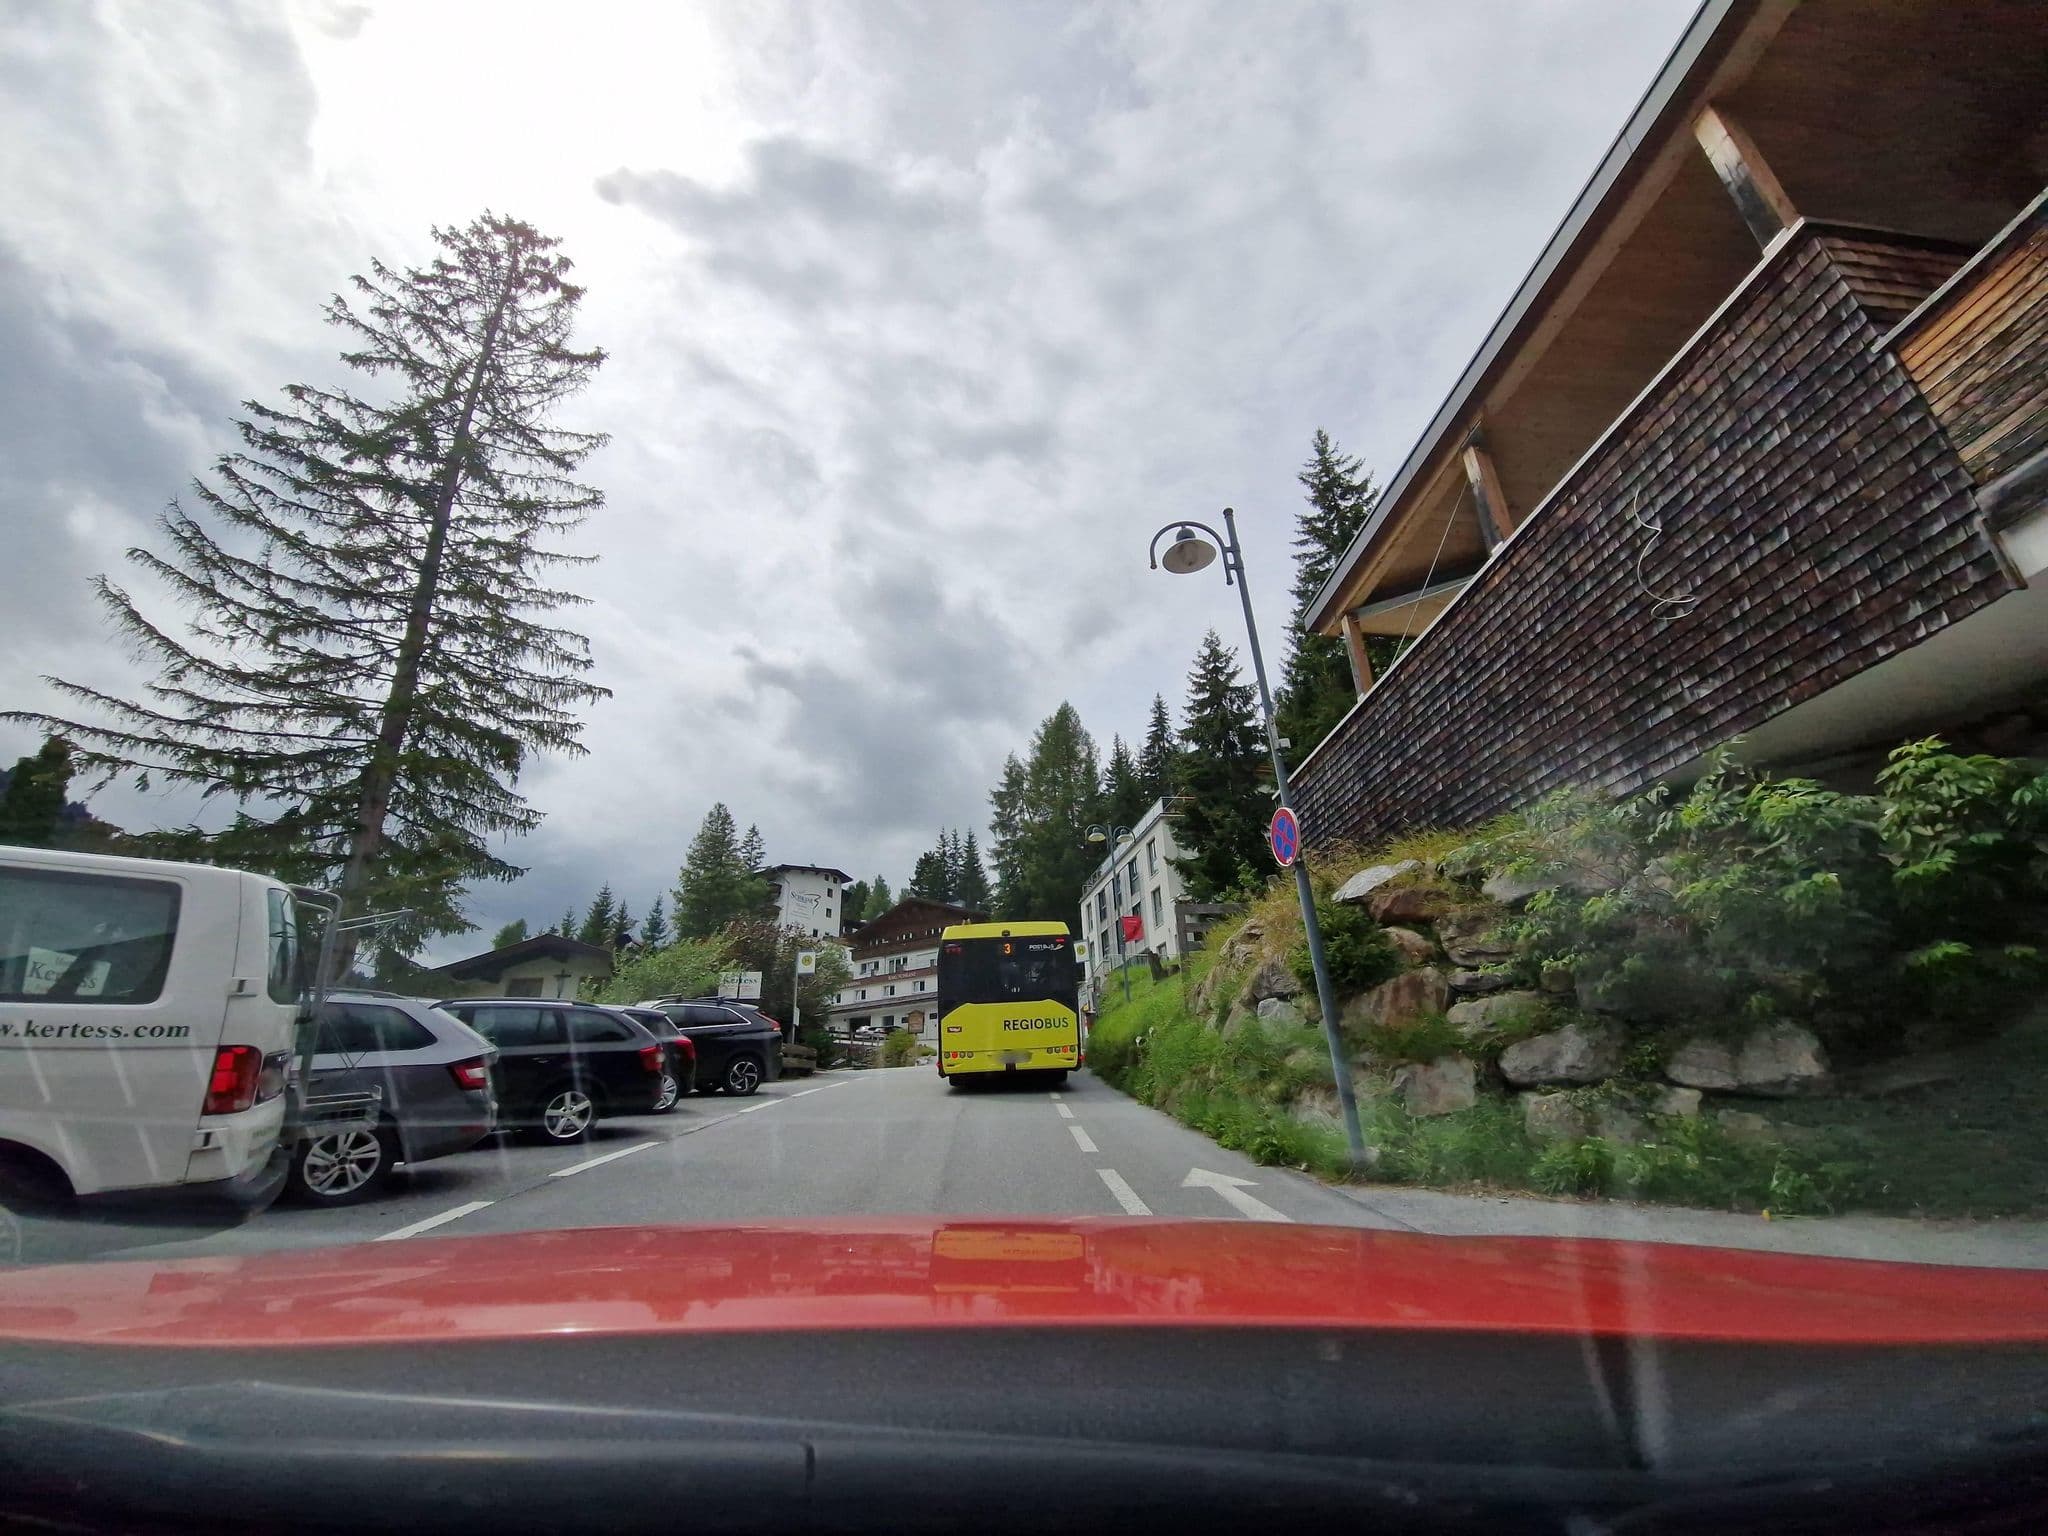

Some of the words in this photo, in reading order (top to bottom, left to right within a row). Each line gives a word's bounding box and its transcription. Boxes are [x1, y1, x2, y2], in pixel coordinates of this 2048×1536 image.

[1004, 943, 1010, 954] 3
[27, 960, 97, 989] Kess
[1003, 1017, 1069, 1032] REGIOBUS
